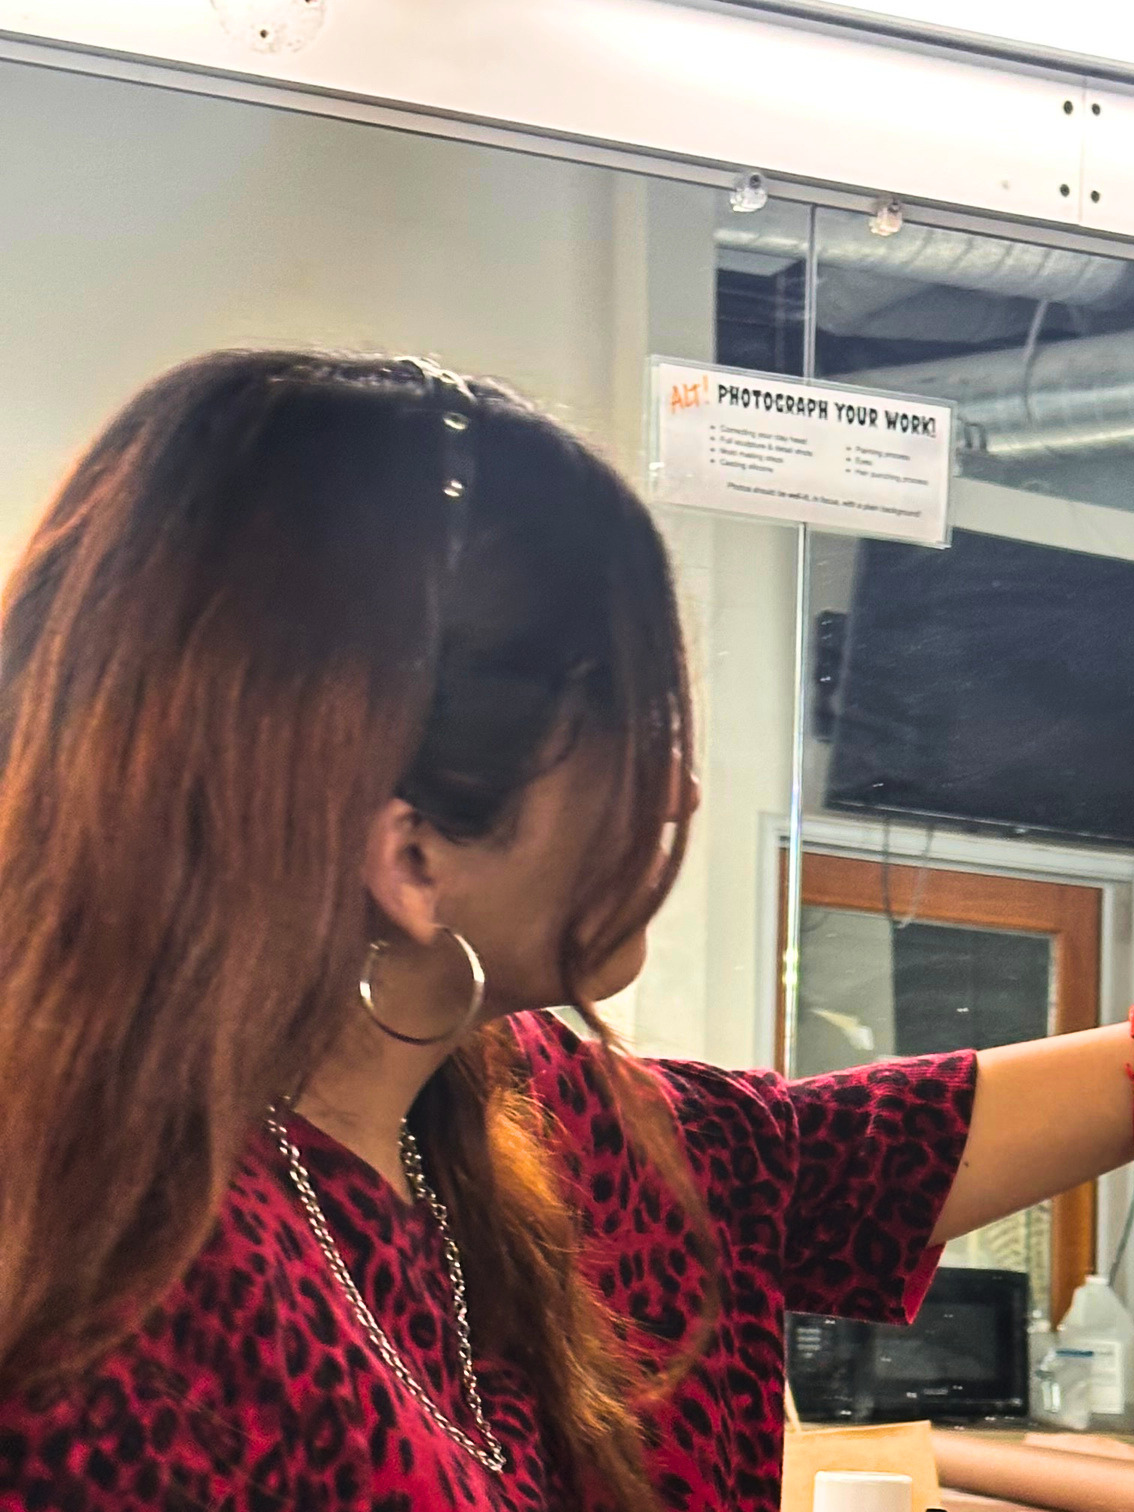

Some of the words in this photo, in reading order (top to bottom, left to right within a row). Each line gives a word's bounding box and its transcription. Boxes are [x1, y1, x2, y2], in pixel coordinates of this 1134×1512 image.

[718, 384, 829, 420] PHOTOGRAPH
[834, 401, 879, 429] YOUR
[884, 410, 937, 438] WORK!
